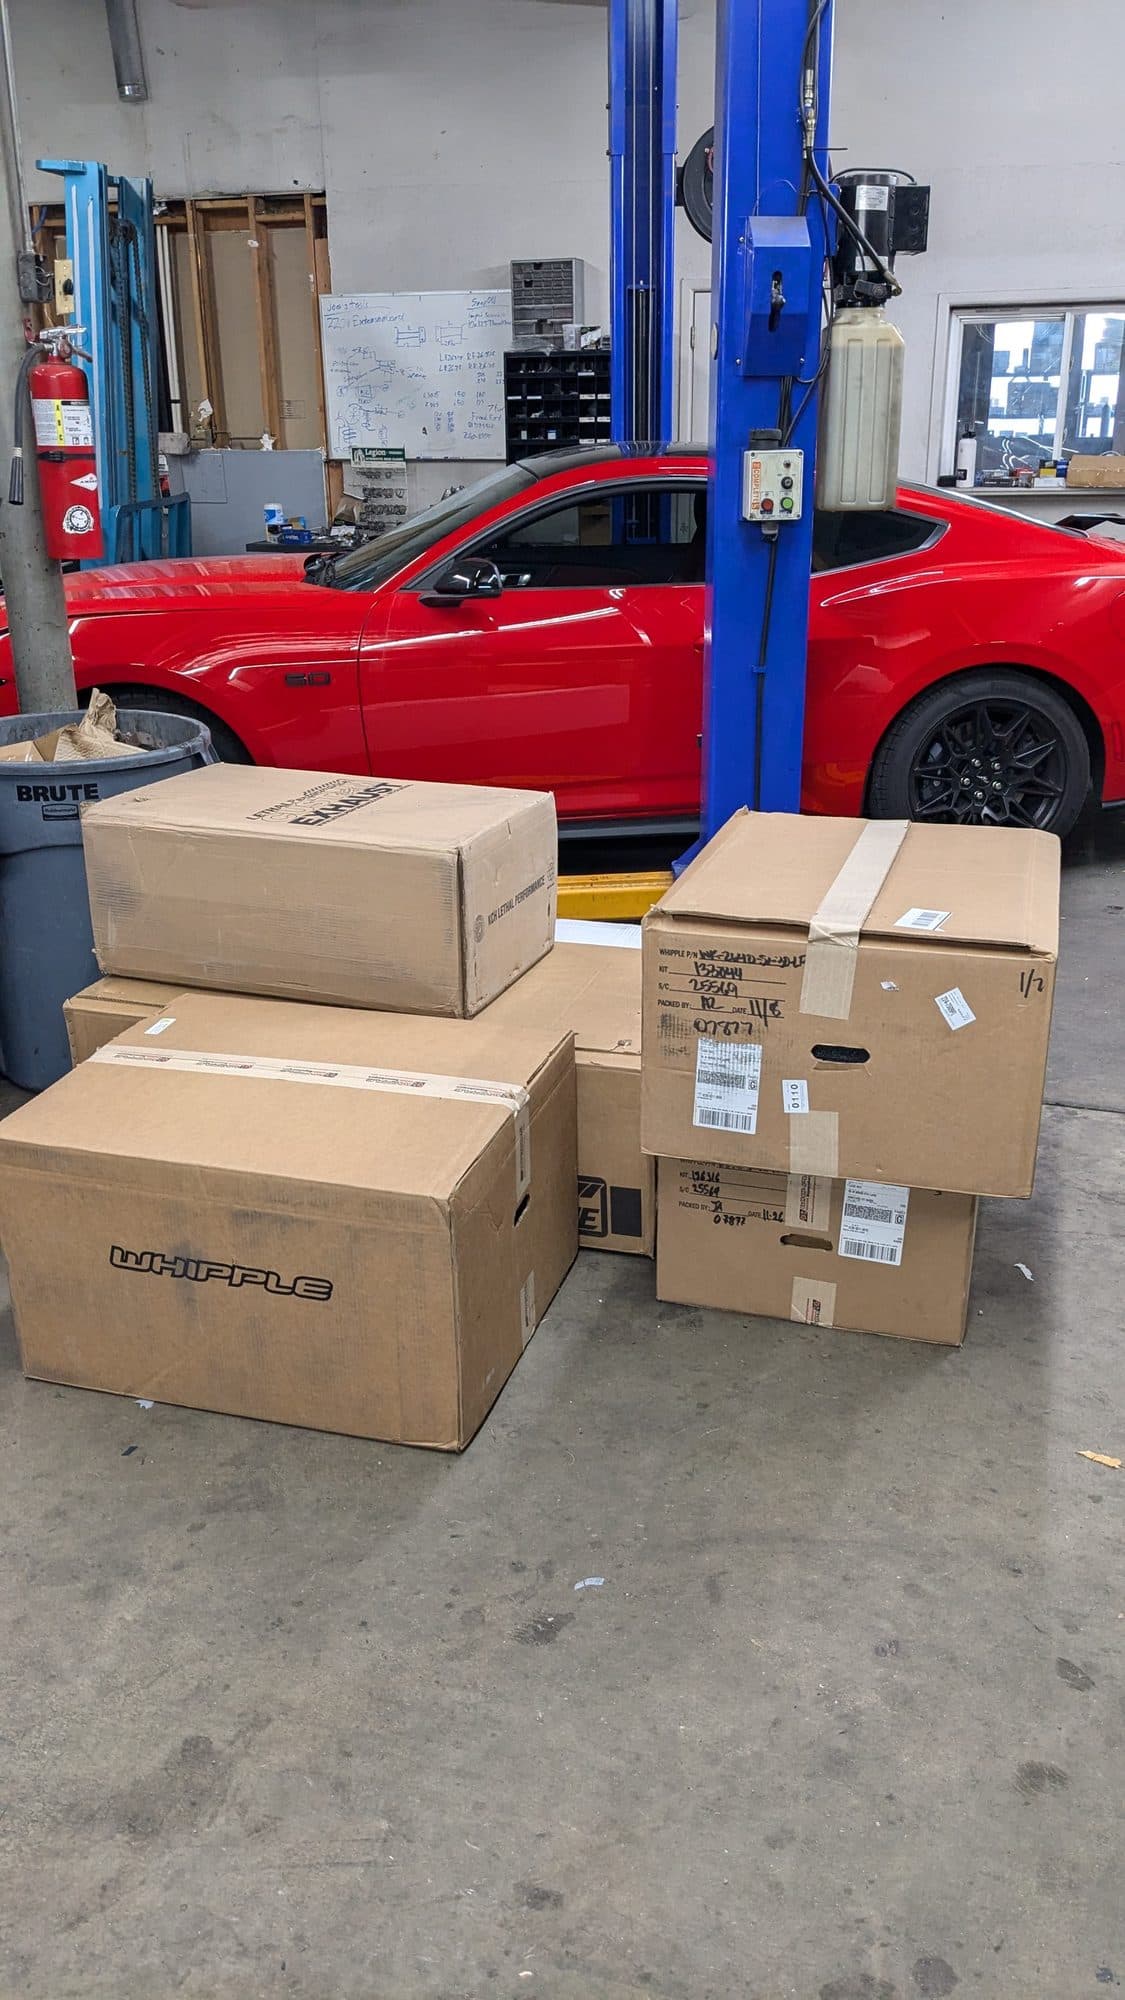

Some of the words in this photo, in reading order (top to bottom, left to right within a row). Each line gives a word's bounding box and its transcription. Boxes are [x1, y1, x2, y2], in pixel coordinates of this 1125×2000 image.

[16, 783, 99, 802] BRUTE
[288, 782, 403, 826] EXHAUST
[658, 948, 685, 958] WHIPPLE
[1020, 968, 1044, 998] 1/2
[790, 1083, 800, 1109] 0110
[110, 1245, 334, 1301] WHIPPLE
